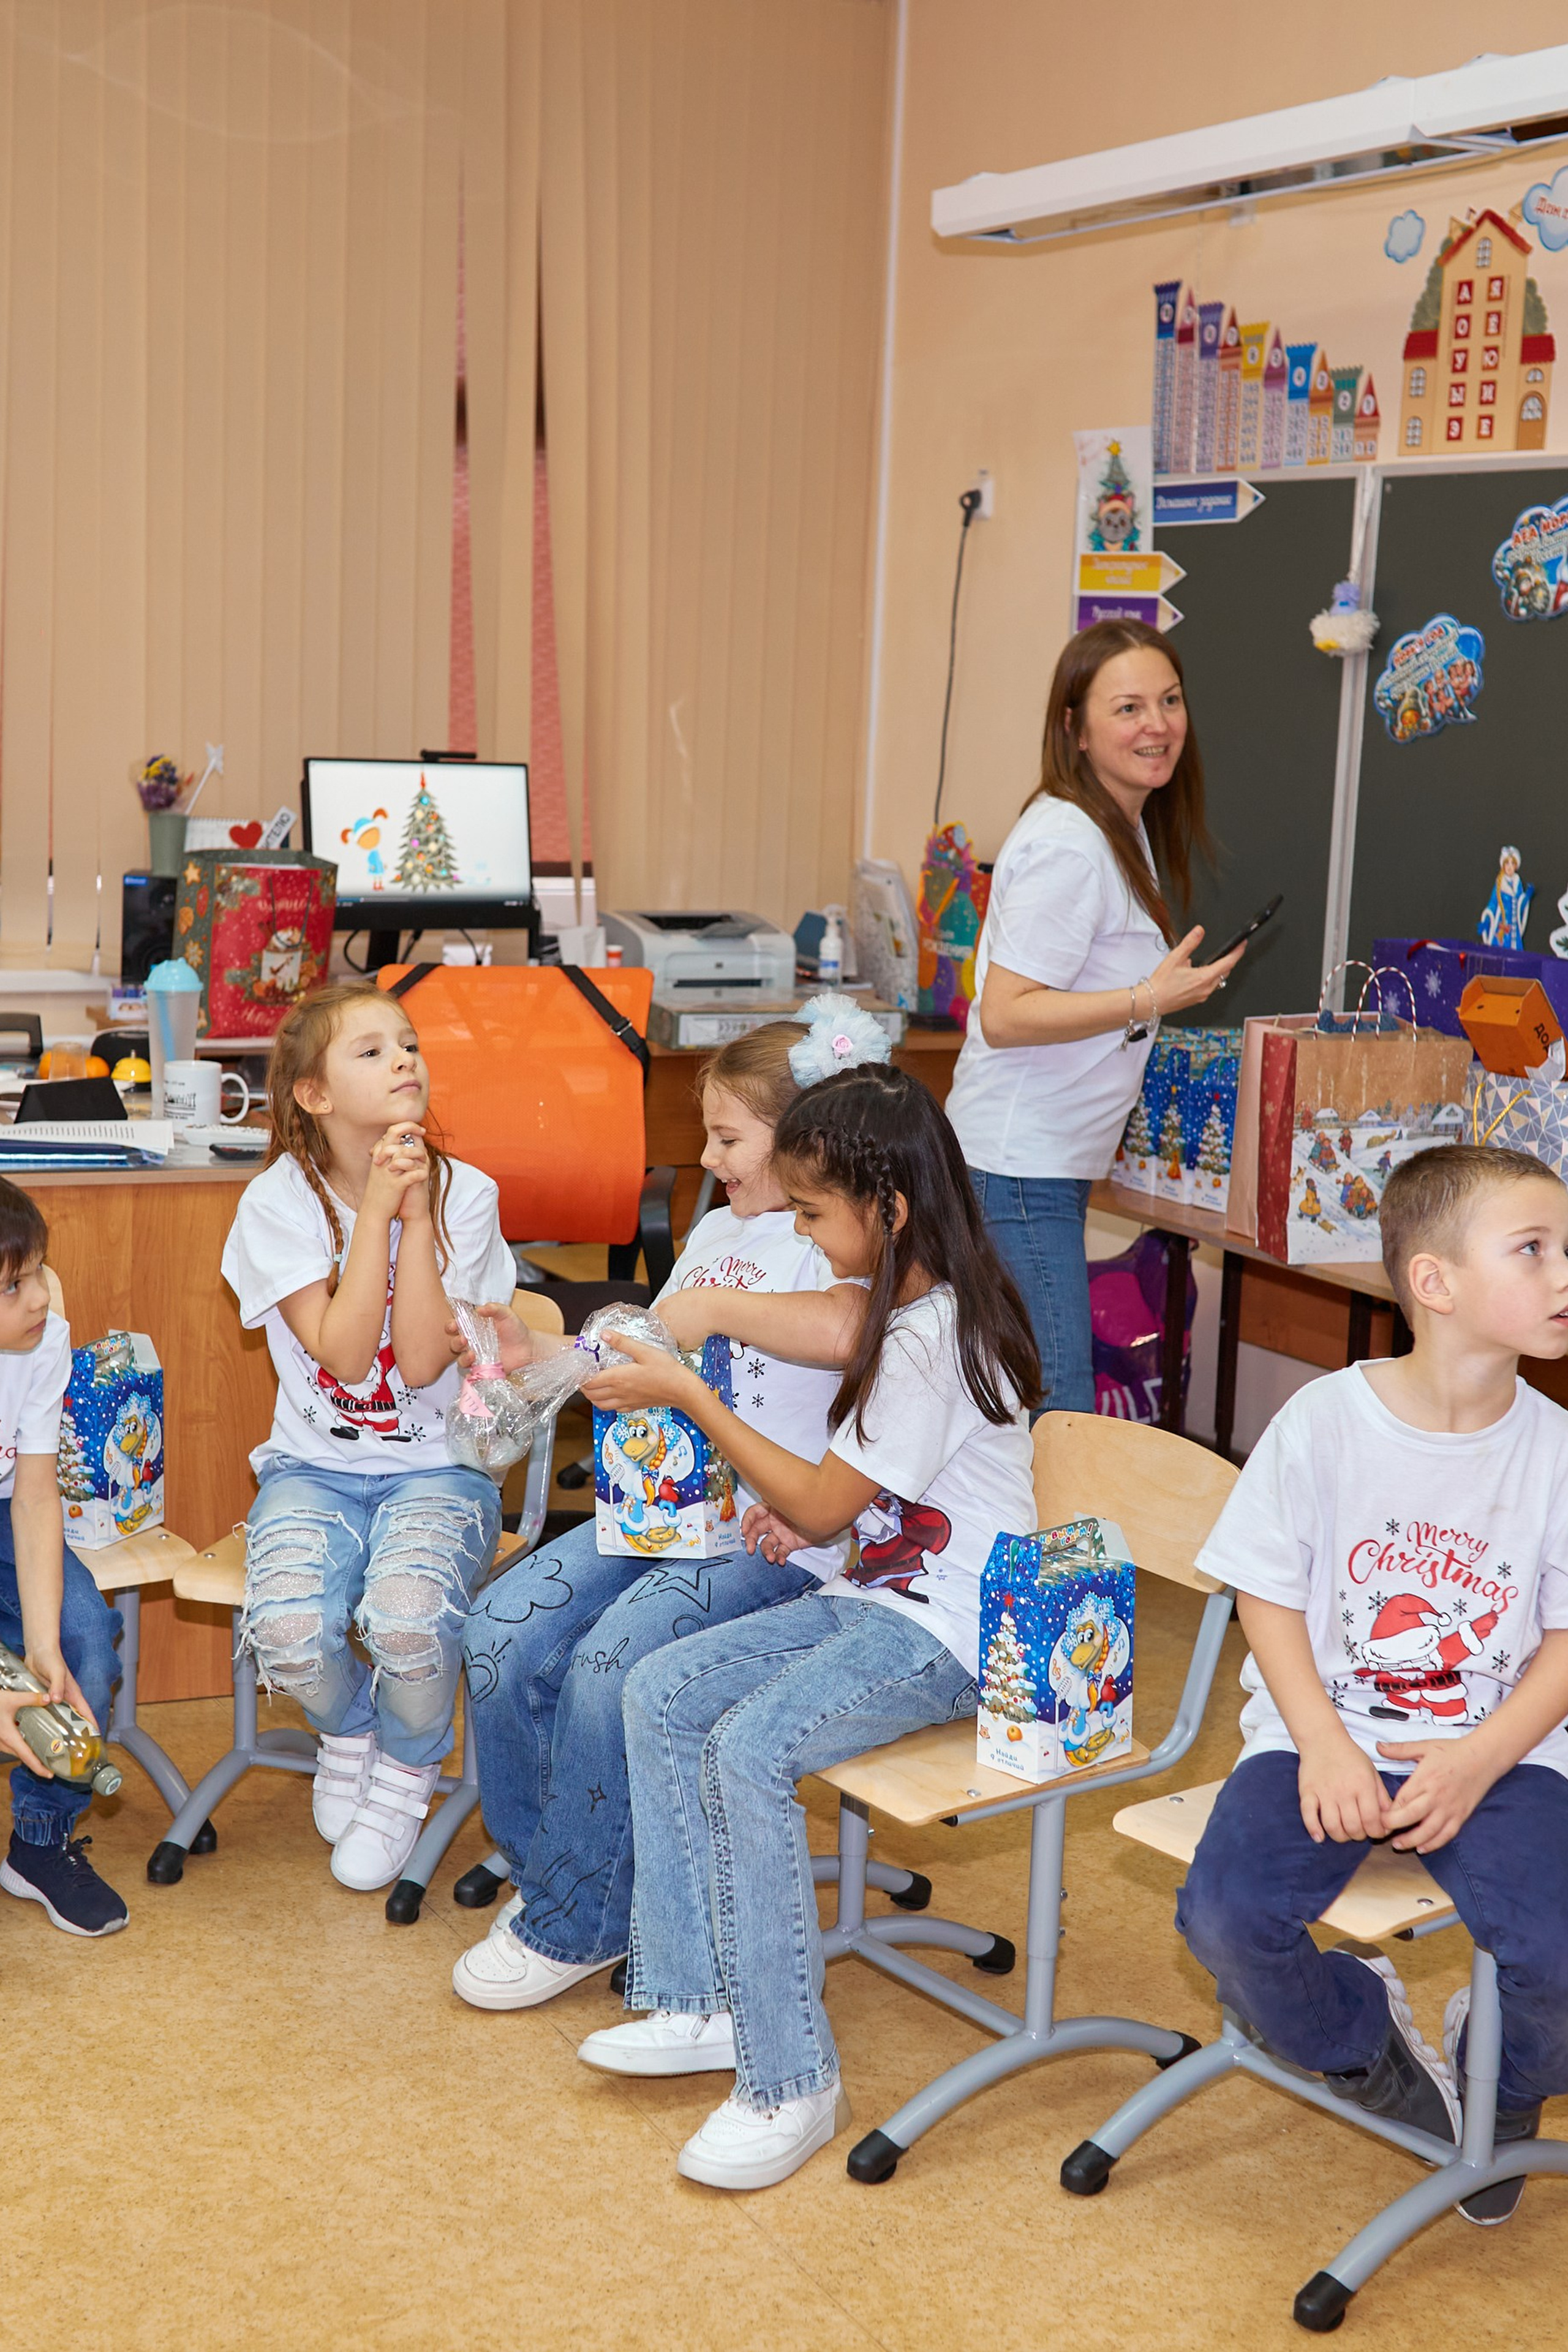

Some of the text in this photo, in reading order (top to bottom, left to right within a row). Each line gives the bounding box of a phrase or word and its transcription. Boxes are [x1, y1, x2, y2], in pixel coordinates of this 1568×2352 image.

[1459, 279, 1502, 302] А Я
[1456, 317, 1469, 336] О
[1454, 348, 1499, 369] У Ю
[1449, 419, 1461, 439] Э
[720, 1256, 767, 1285] Merry
[1039, 1525, 1074, 1545] НОВЫМ
[1060, 1522, 1093, 1546] ГОДОМ!
[1407, 1521, 1489, 1562] Merry
[1348, 1539, 1519, 1615] Christmas
[996, 1748, 1018, 1762] Найди
[997, 1758, 1025, 1771] отличий
